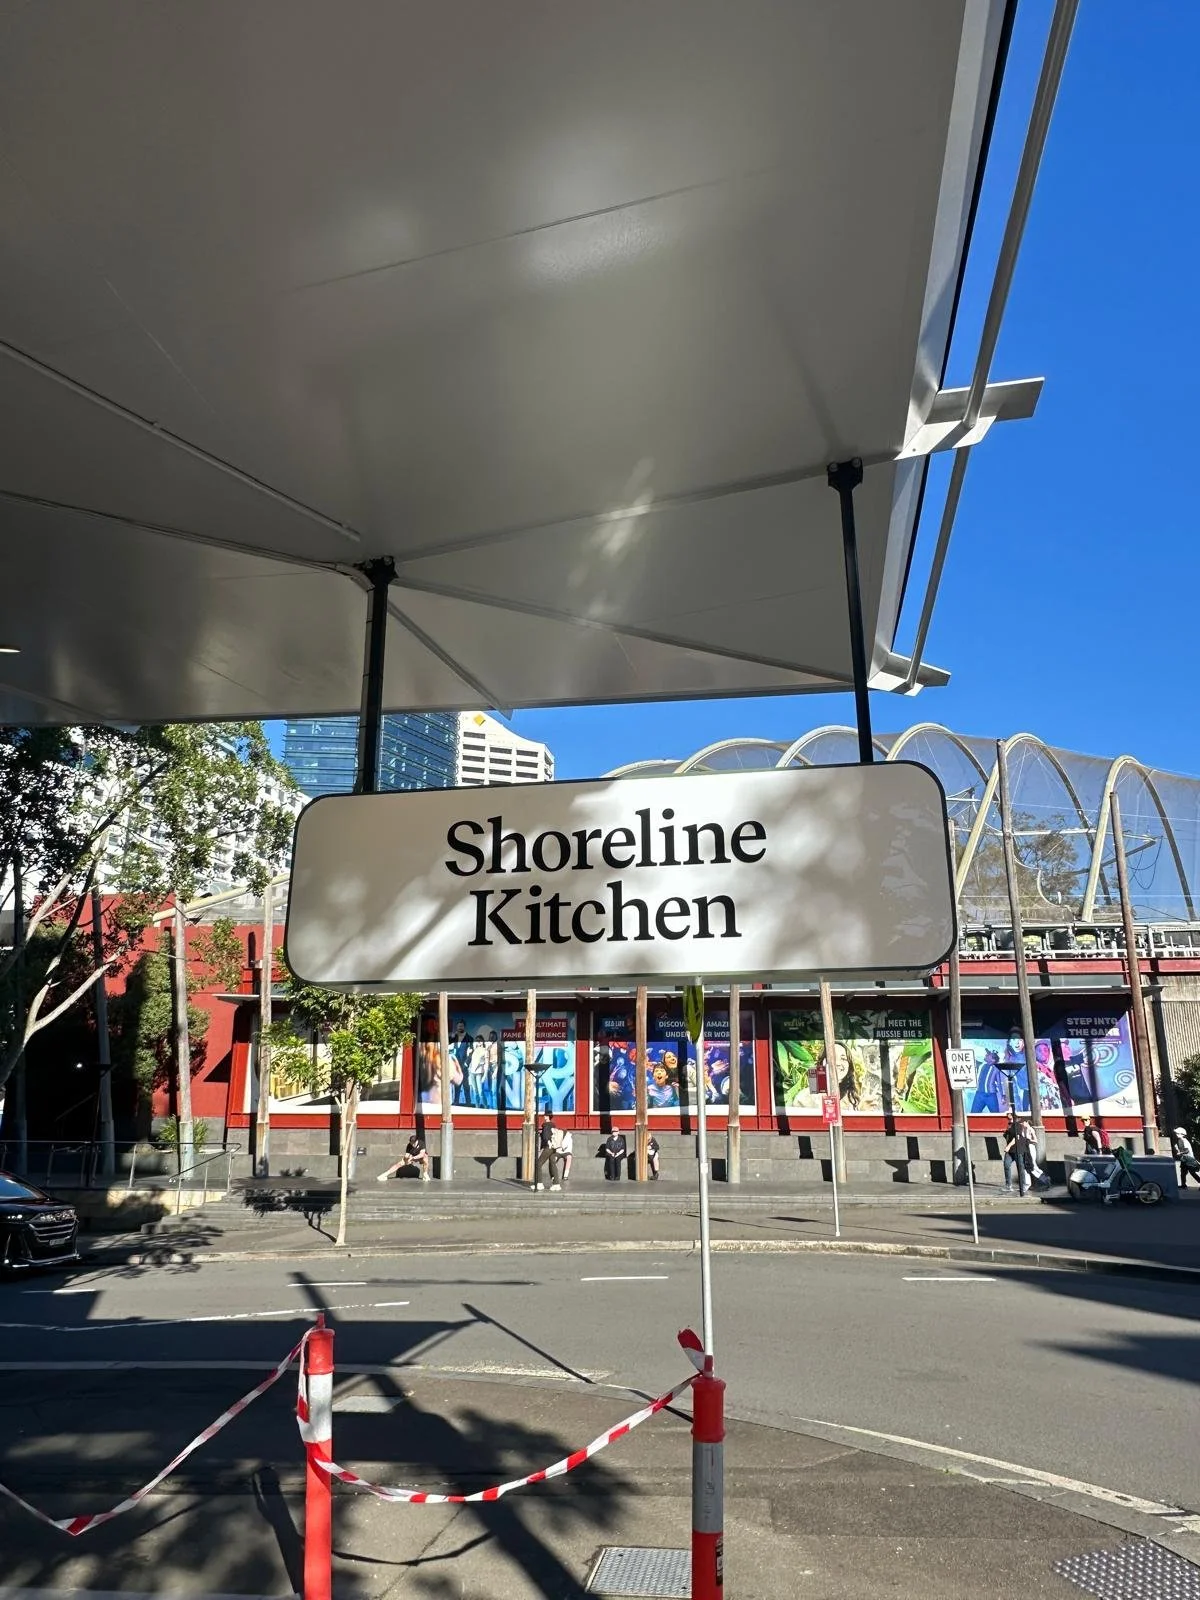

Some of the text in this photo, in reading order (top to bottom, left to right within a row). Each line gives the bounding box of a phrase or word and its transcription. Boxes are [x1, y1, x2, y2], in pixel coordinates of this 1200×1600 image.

[445, 808, 767, 877] Shoreline
[468, 881, 742, 945] Kitchen
[888, 1019, 922, 1027] MEET THE
[1066, 1017, 1118, 1025] STEP INTO
[876, 1030, 922, 1038] AUSSIE BIG 5
[1068, 1028, 1089, 1036] THE
[951, 1053, 970, 1062] ONE
[952, 1064, 972, 1074] WAY
